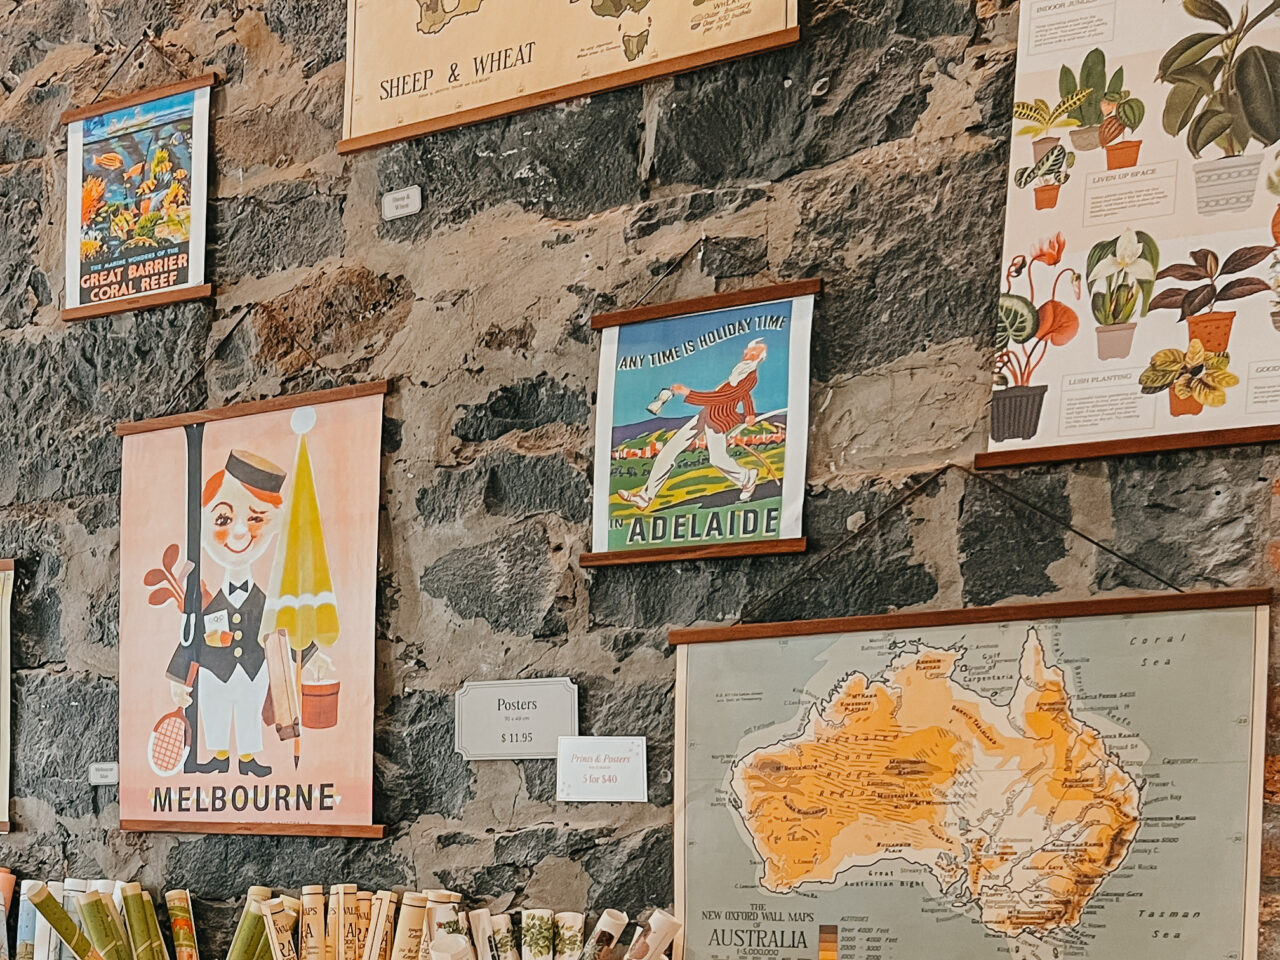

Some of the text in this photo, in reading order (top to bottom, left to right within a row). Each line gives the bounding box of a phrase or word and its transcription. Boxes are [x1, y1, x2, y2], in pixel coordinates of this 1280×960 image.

[380, 69, 434, 101] SHEEP
[448, 62, 460, 84] &
[474, 41, 536, 77] WHEAT
[104, 259, 126, 268] MARINE
[128, 252, 155, 263] WONDERS
[157, 249, 166, 257] OF
[80, 253, 188, 289] GREAT BARRIER
[90, 271, 178, 302] CORAL REEF
[618, 315, 788, 371] ANY TIME IS HOLIDAY TIME
[610, 507, 779, 545] IN ADELAIDE
[1130, 633, 1186, 646] Coral
[1141, 657, 1171, 667] Sea
[497, 697, 537, 711] Posters
[501, 732, 533, 743] $ 11.95
[571, 753, 631, 764] Prints & Posters
[583, 774, 617, 784] 5 for $40
[153, 783, 334, 812] MELBOURNE
[900, 881, 924, 889] Bight
[750, 903, 766, 912] THE
[1138, 909, 1201, 918] Tasman
[702, 911, 815, 923] NEW OXFORD WALL MAPS
[708, 929, 808, 949] AUSTRALIA
[1152, 930, 1181, 939] Sea
